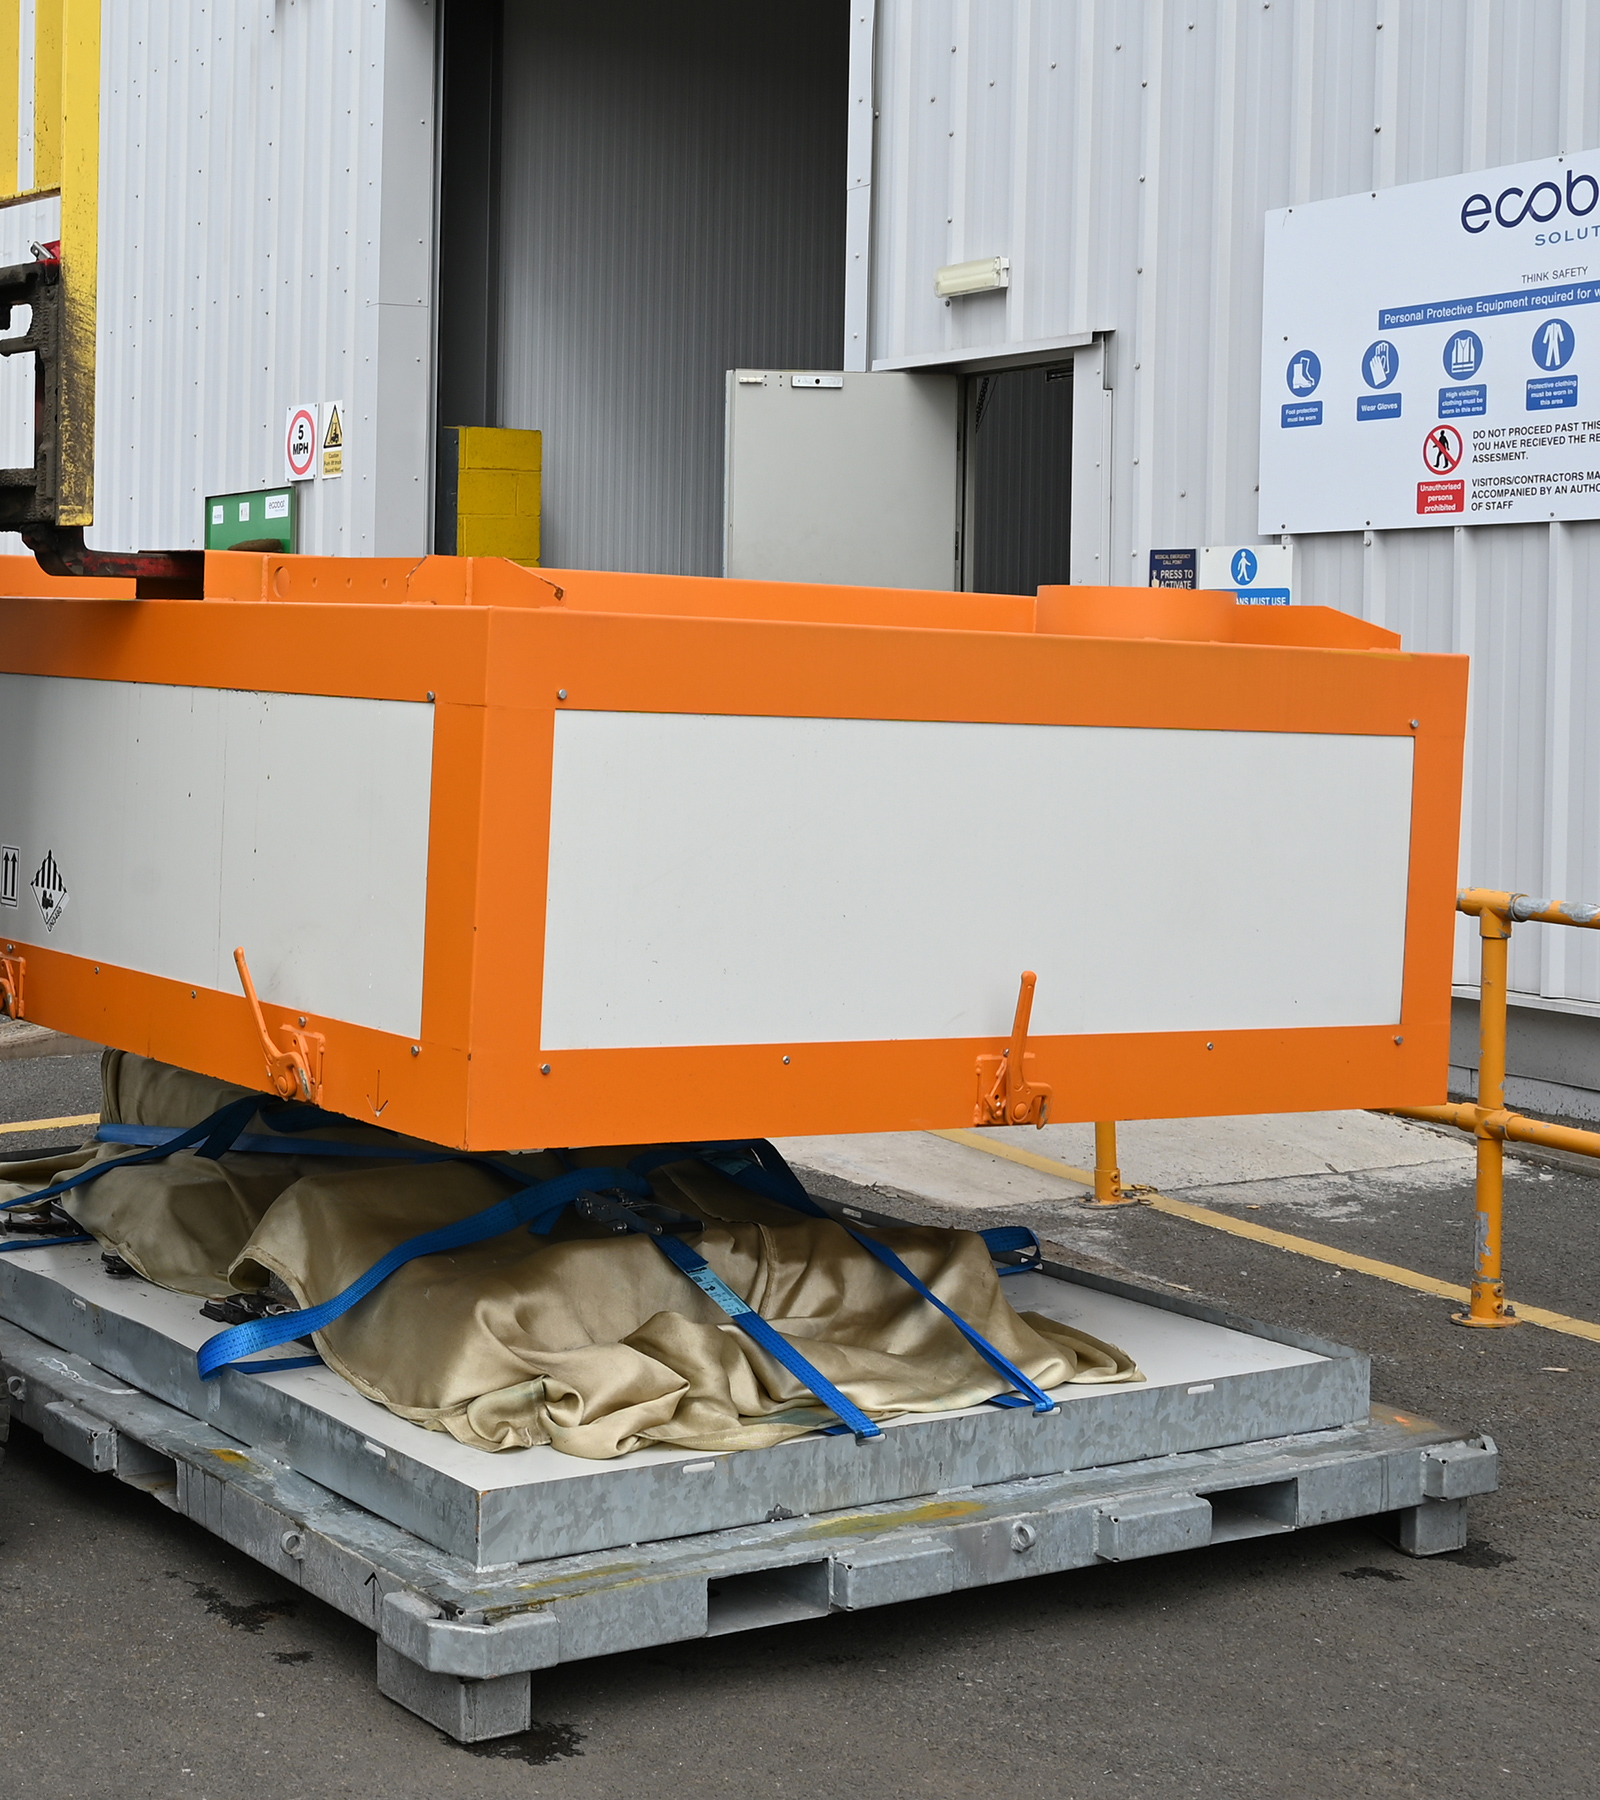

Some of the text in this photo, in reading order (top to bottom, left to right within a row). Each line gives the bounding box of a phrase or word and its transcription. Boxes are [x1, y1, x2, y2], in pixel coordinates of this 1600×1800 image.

[1460, 169, 1600, 234] ecob
[1521, 266, 1589, 284] THINK SAFETY
[1384, 309, 1424, 325] Personal
[1426, 304, 1474, 319] Protective
[1476, 296, 1529, 314] Equipment
[1530, 289, 1574, 306] required
[1576, 288, 1592, 300] for
[1527, 380, 1577, 390] Protective clothing
[1445, 389, 1480, 399] High visibility
[1360, 402, 1398, 412] Wear Gloves
[1441, 399, 1463, 407] clothing
[1296, 406, 1319, 416] protection
[298, 424, 304, 440] 5
[1472, 420, 1600, 440] DO NOT PROCEED PAST THIS
[1472, 432, 1600, 452] YOU HAVE RECIEVED THE RE
[292, 442, 309, 456] MPH
[1472, 451, 1529, 464] ASSESMENT.
[1472, 472, 1584, 488] VISITORS/CONTRACTORS
[1420, 482, 1462, 492] Unauthorised
[1472, 486, 1538, 500] ACCOMPANIED
[1540, 486, 1552, 496] BY
[1554, 484, 1568, 494] AN
[1428, 494, 1454, 504] persons
[1424, 503, 1456, 514] prohibited
[1471, 500, 1514, 512] OF STAFF
[1160, 569, 1194, 579] PRESS TO
[1160, 580, 1192, 590] ACTIVATE
[1250, 597, 1271, 606] MUST
[1271, 596, 1287, 606] USE
